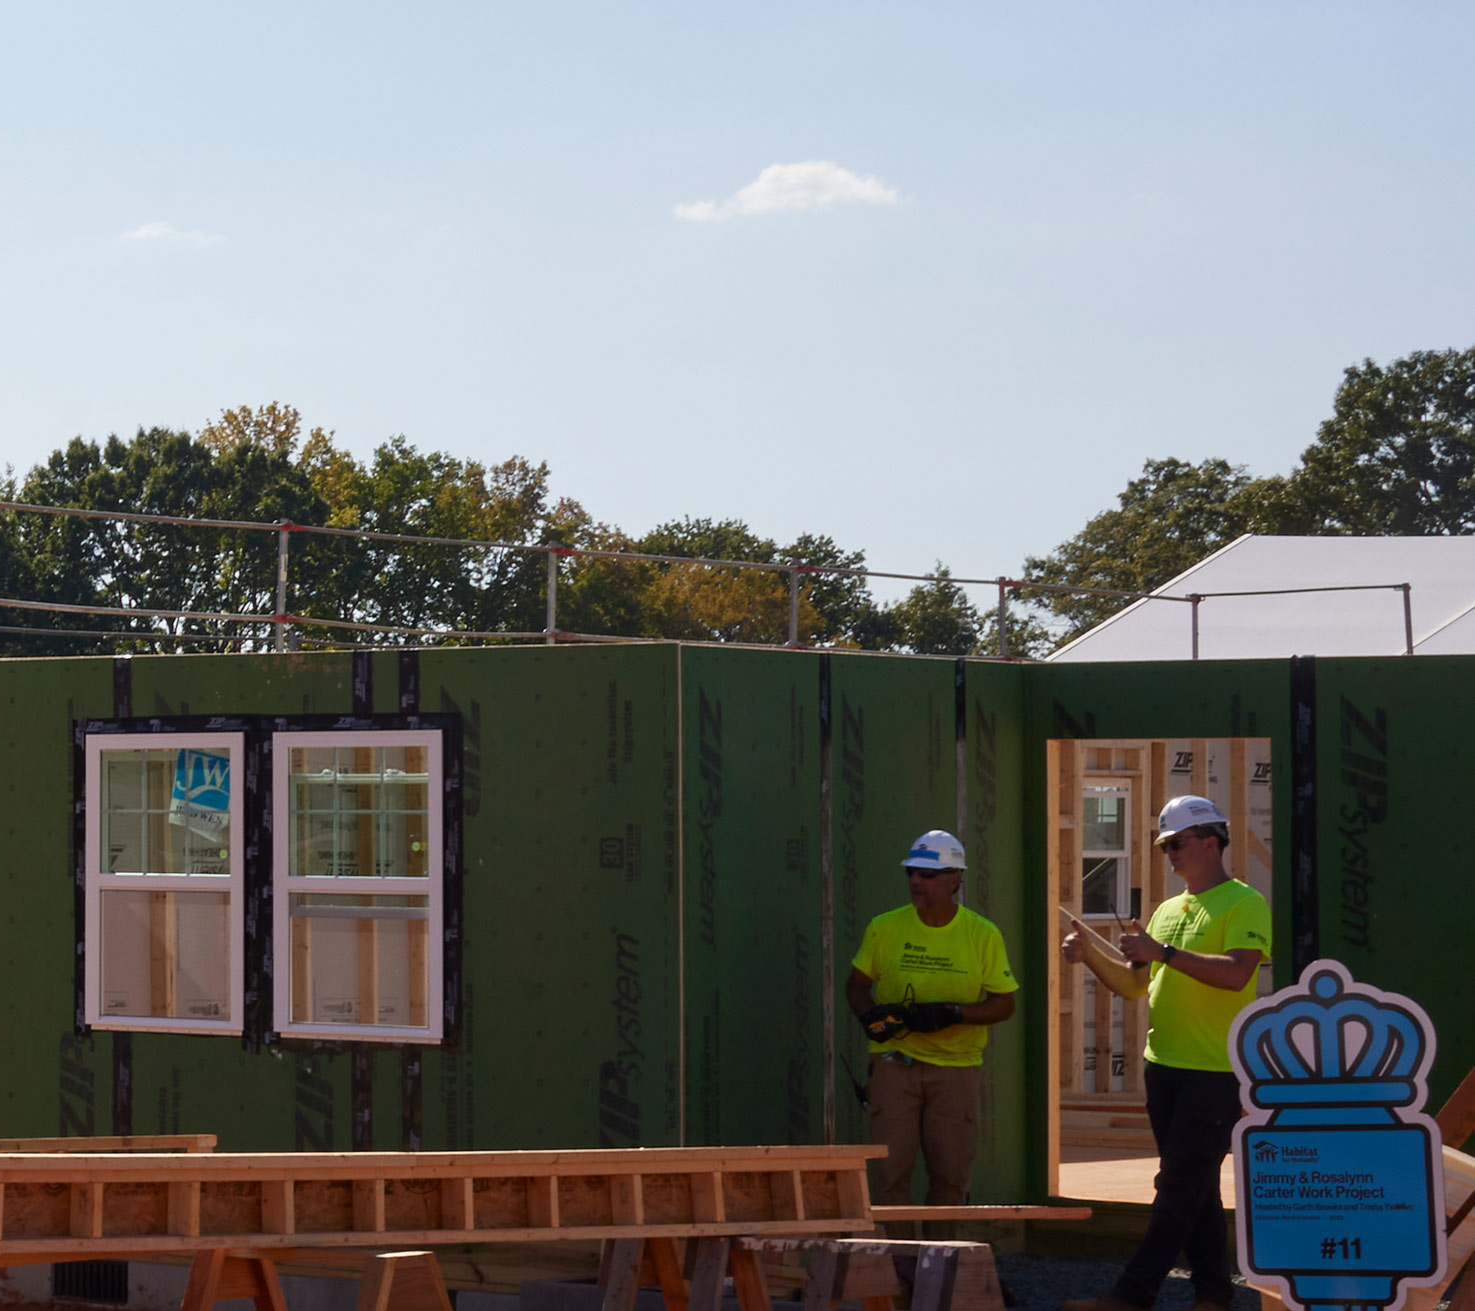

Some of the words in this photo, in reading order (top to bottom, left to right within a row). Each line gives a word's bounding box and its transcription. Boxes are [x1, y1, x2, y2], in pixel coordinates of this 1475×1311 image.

[1281, 1146, 1318, 1156] Habitat
[1253, 1172, 1296, 1185] Jimmy
[1299, 1172, 1308, 1184] &
[1311, 1171, 1374, 1185] Rosalynn
[1253, 1187, 1295, 1199] Carter
[1297, 1187, 1333, 1199] Work
[1335, 1187, 1385, 1200] Project
[1320, 1237, 1362, 1260] #11
